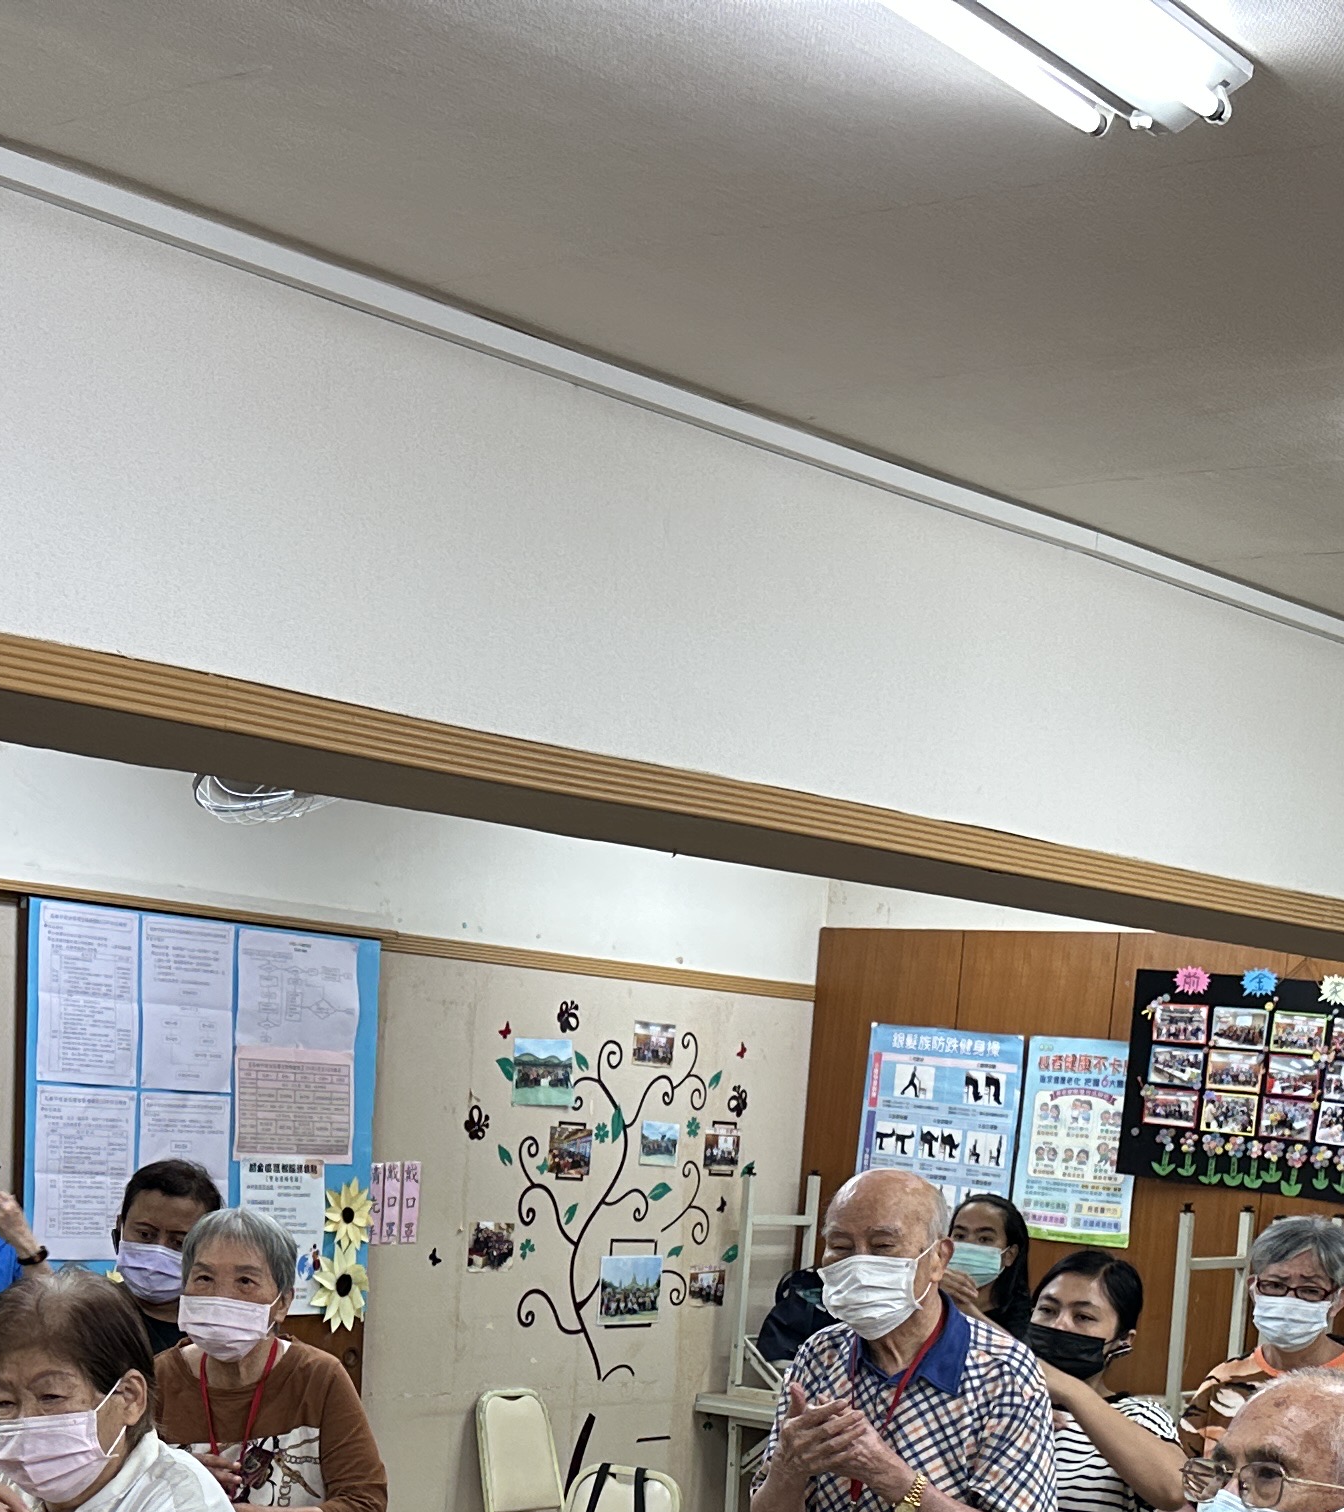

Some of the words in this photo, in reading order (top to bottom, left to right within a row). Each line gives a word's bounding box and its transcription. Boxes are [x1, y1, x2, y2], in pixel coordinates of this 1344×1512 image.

[1183, 973, 1201, 991] 前
[1249, 973, 1272, 992] 金
[891, 1032, 1001, 1057] 銀髮族防跌健身操
[384, 1163, 401, 1241] 戴口罩
[402, 1163, 419, 1242] 戴口罩
